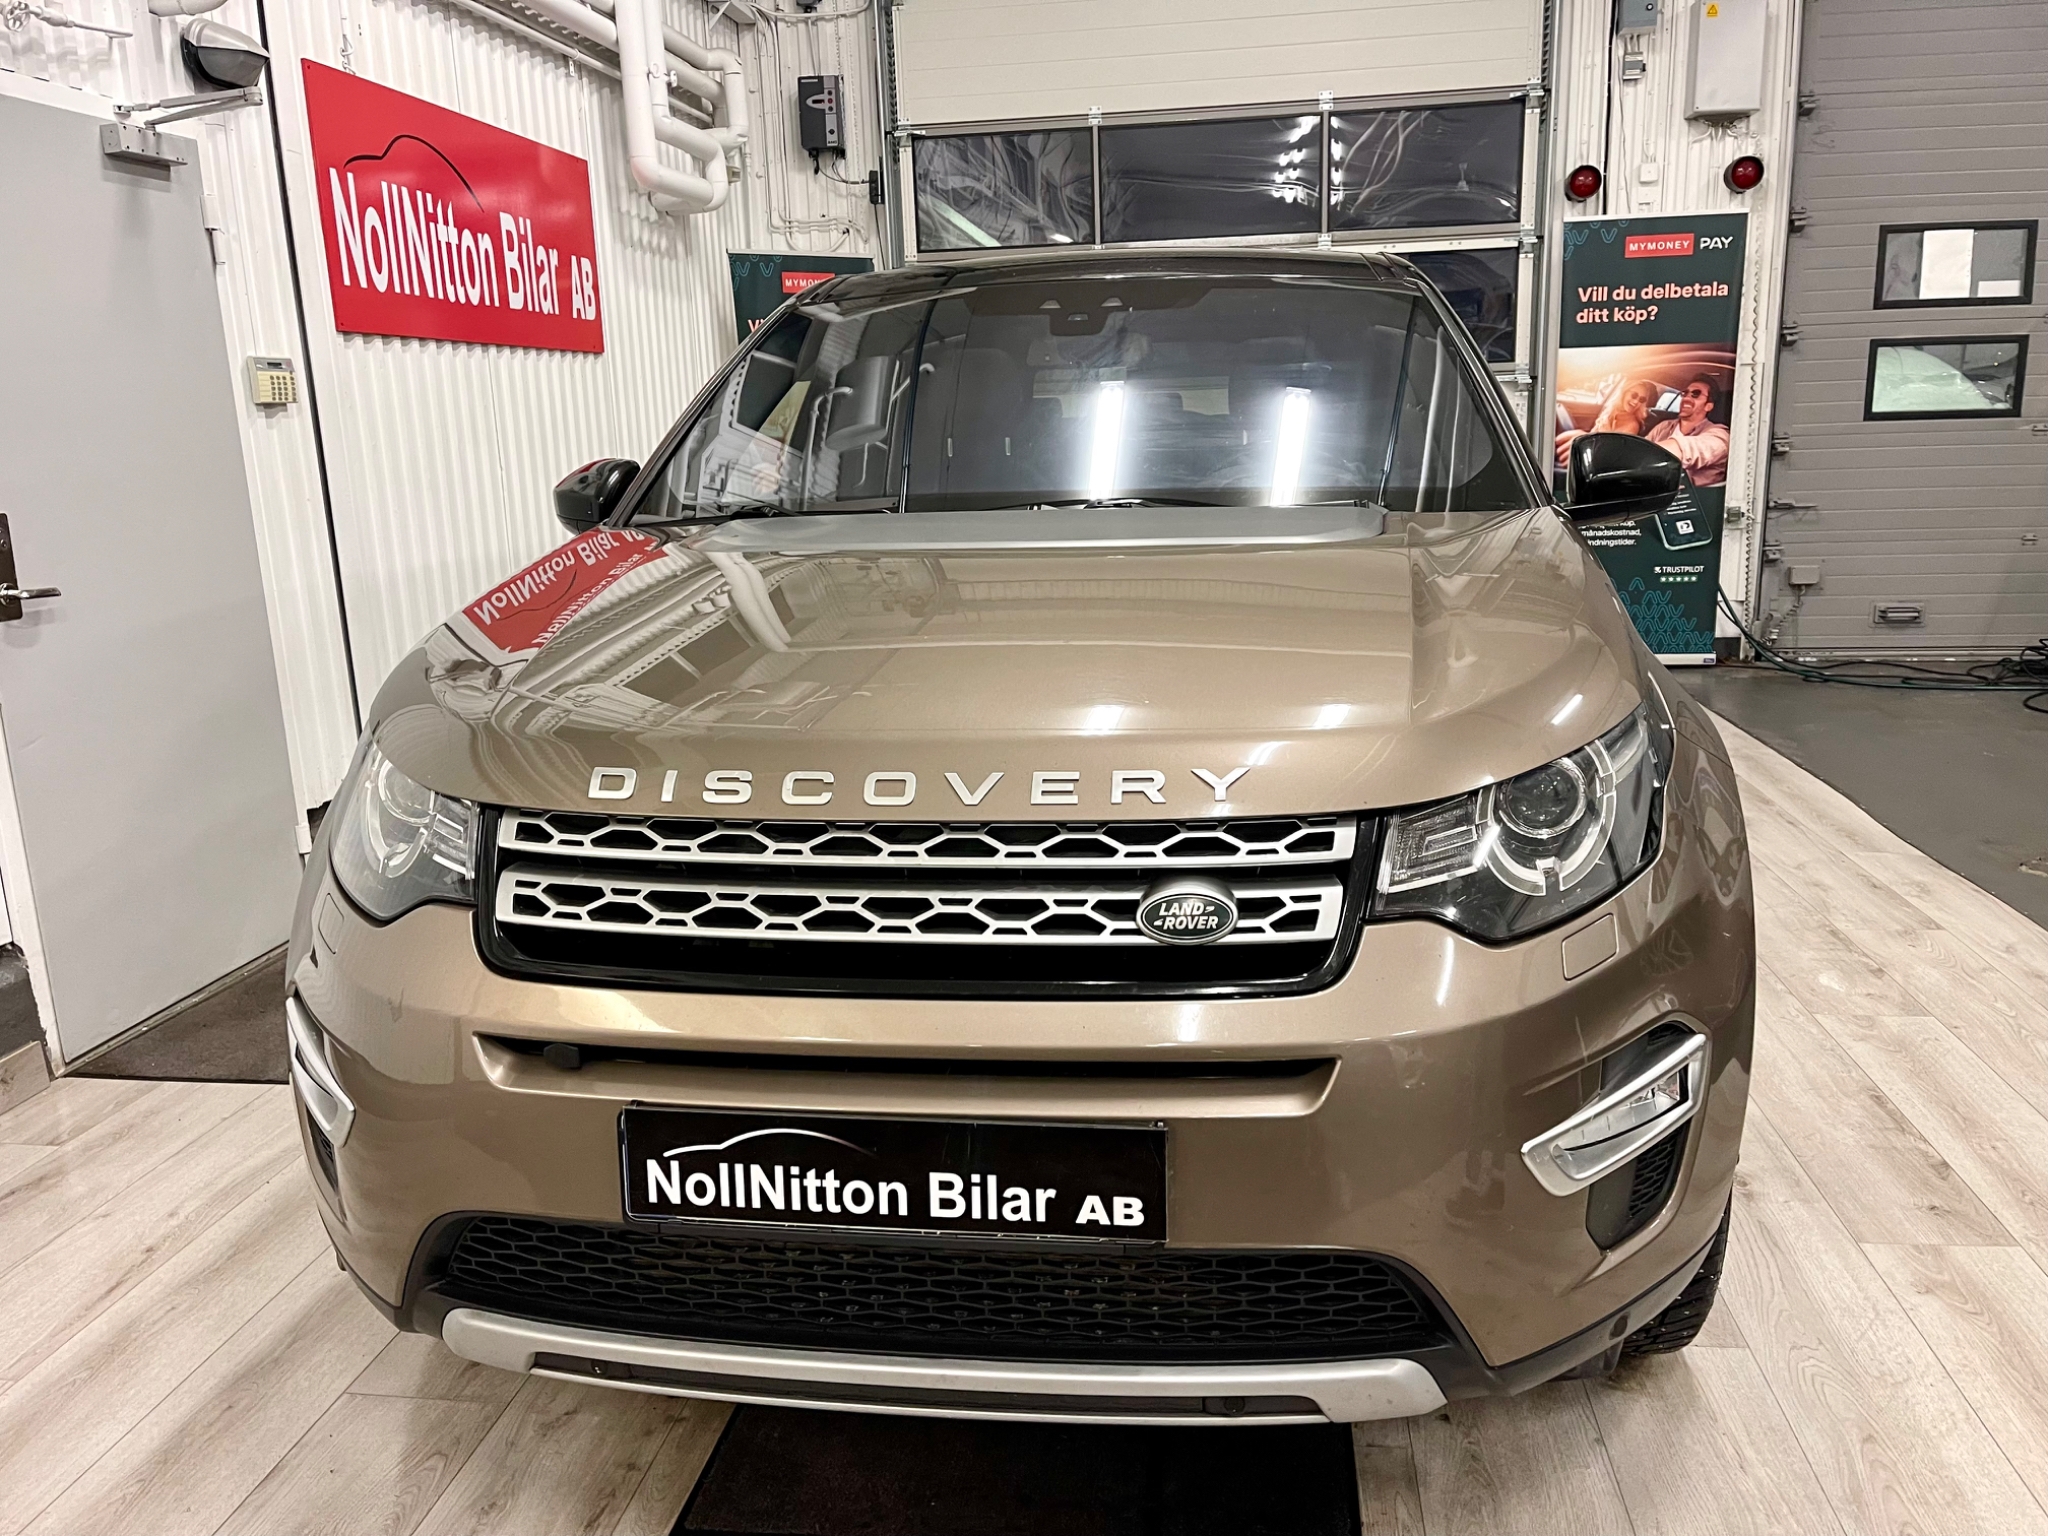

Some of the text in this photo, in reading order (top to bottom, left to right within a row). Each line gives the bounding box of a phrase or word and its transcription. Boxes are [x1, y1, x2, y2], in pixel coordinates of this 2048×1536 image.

[329, 167, 596, 320] NollNitton Bilar AB
[1629, 236, 1734, 252] MYMONEY PAY
[1578, 281, 1729, 302] Vill du delbetala
[1576, 305, 1659, 325] ditt köp?
[1662, 565, 1705, 574] TRUSTPILOT
[587, 767, 1251, 806] DISCOVERY
[1159, 902, 1205, 916] LAND
[1163, 915, 1219, 930] ROVER
[645, 1158, 1145, 1227] NollNitton Bilar AB
